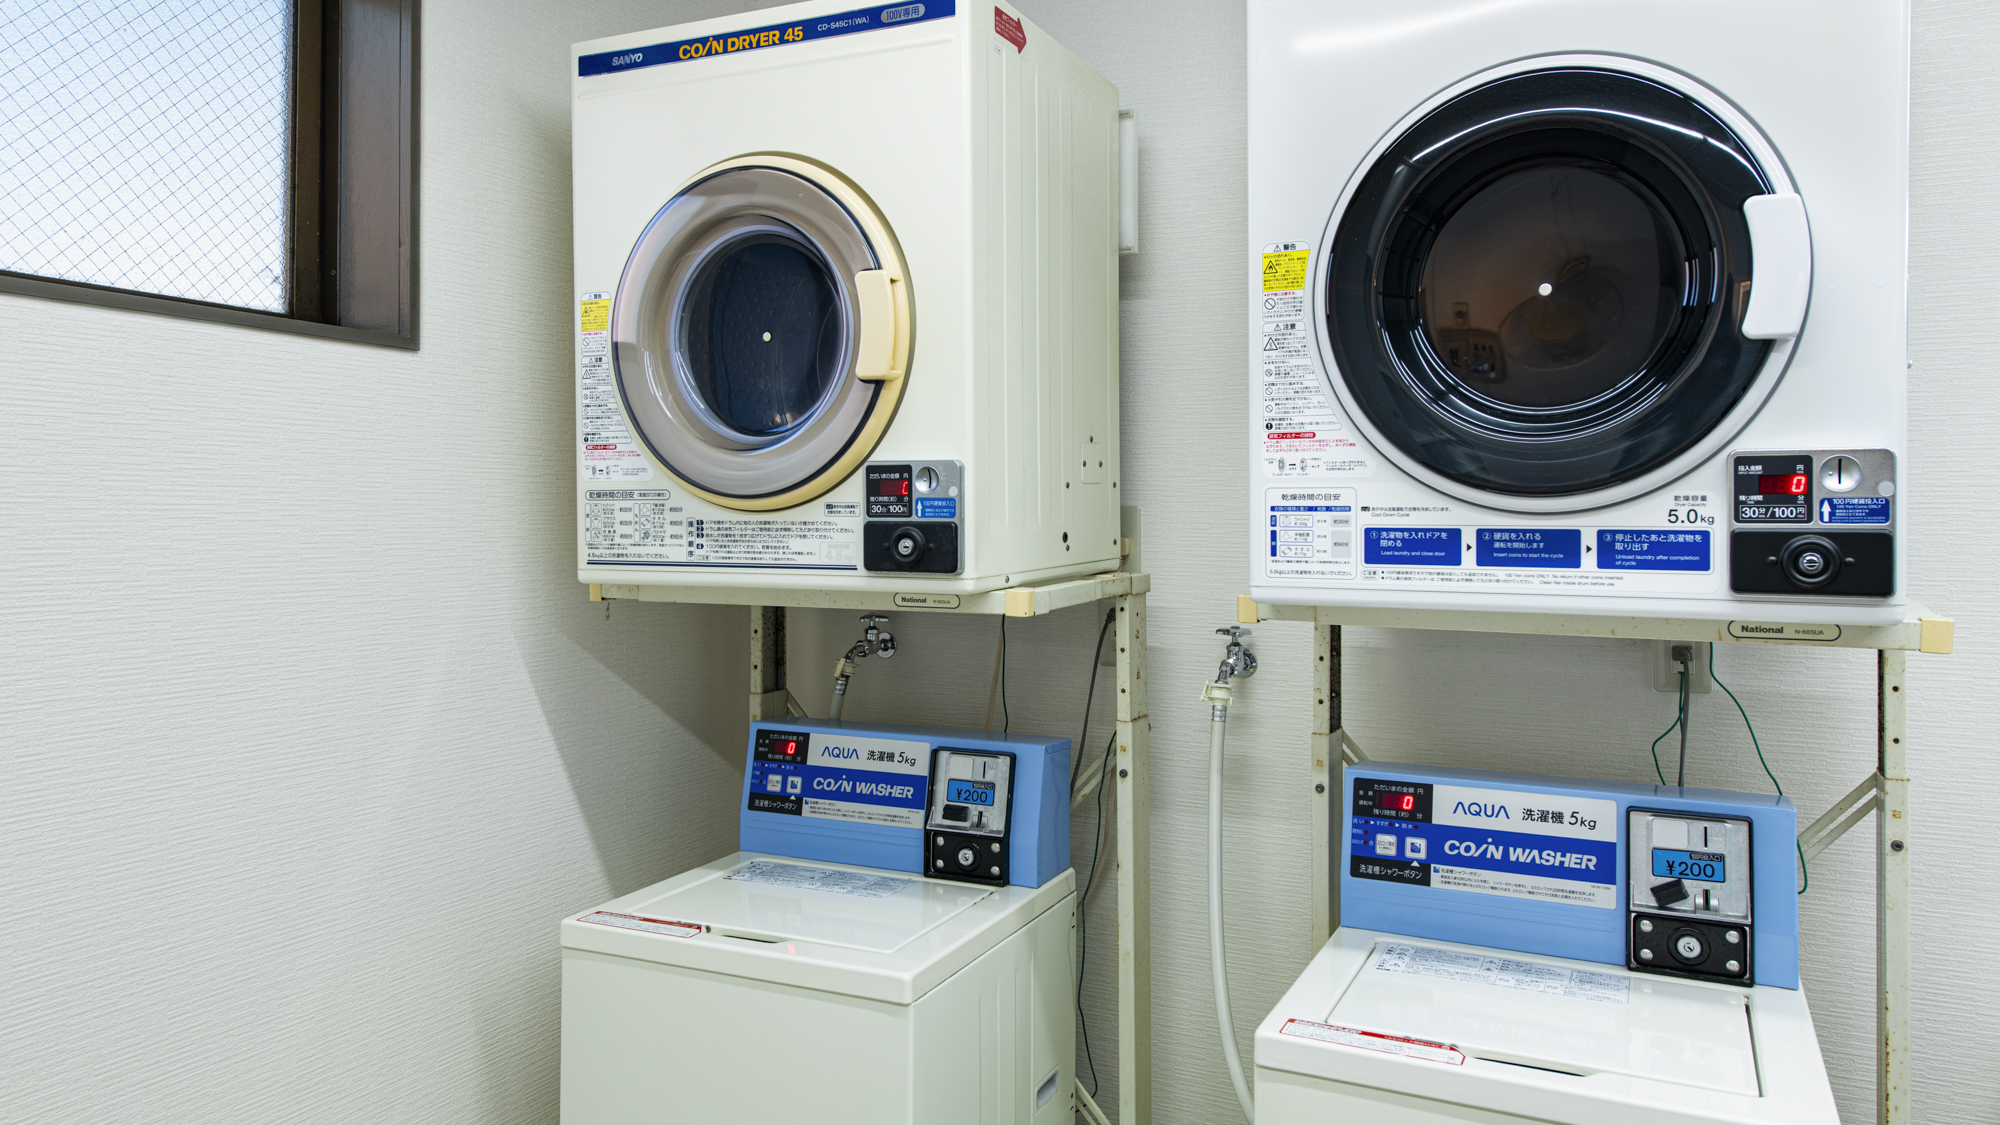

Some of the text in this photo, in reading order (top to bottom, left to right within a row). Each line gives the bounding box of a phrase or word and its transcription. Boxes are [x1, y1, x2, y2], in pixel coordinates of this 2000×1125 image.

[886, 6, 920, 20] 100V専用
[678, 26, 804, 60] COIN DRYER 45
[612, 53, 643, 66] SANYO
[1792, 476, 1805, 492] 0
[1668, 509, 1714, 525] 5.0 kg
[1380, 531, 1448, 539] 洗濯物を入れドアを
[1615, 534, 1702, 542] 停止したあと洗濯物を
[1615, 543, 1649, 551] 取り出す
[1741, 625, 1784, 634] National
[788, 742, 796, 754] 0
[821, 746, 859, 760] AQUA
[866, 750, 895, 763] 洗濯機
[813, 775, 914, 798] COIN WASHER
[1374, 784, 1414, 793] ただいまの金額
[956, 788, 988, 803] ¥200
[1403, 795, 1414, 810] 0
[1453, 801, 1510, 820] AQUA
[1522, 807, 1564, 824] 洗濯機
[1444, 838, 1597, 870] COIN WASHER
[1359, 864, 1422, 879] 洗濯槽シャワーボタン
[1666, 860, 1715, 878] ¥200
